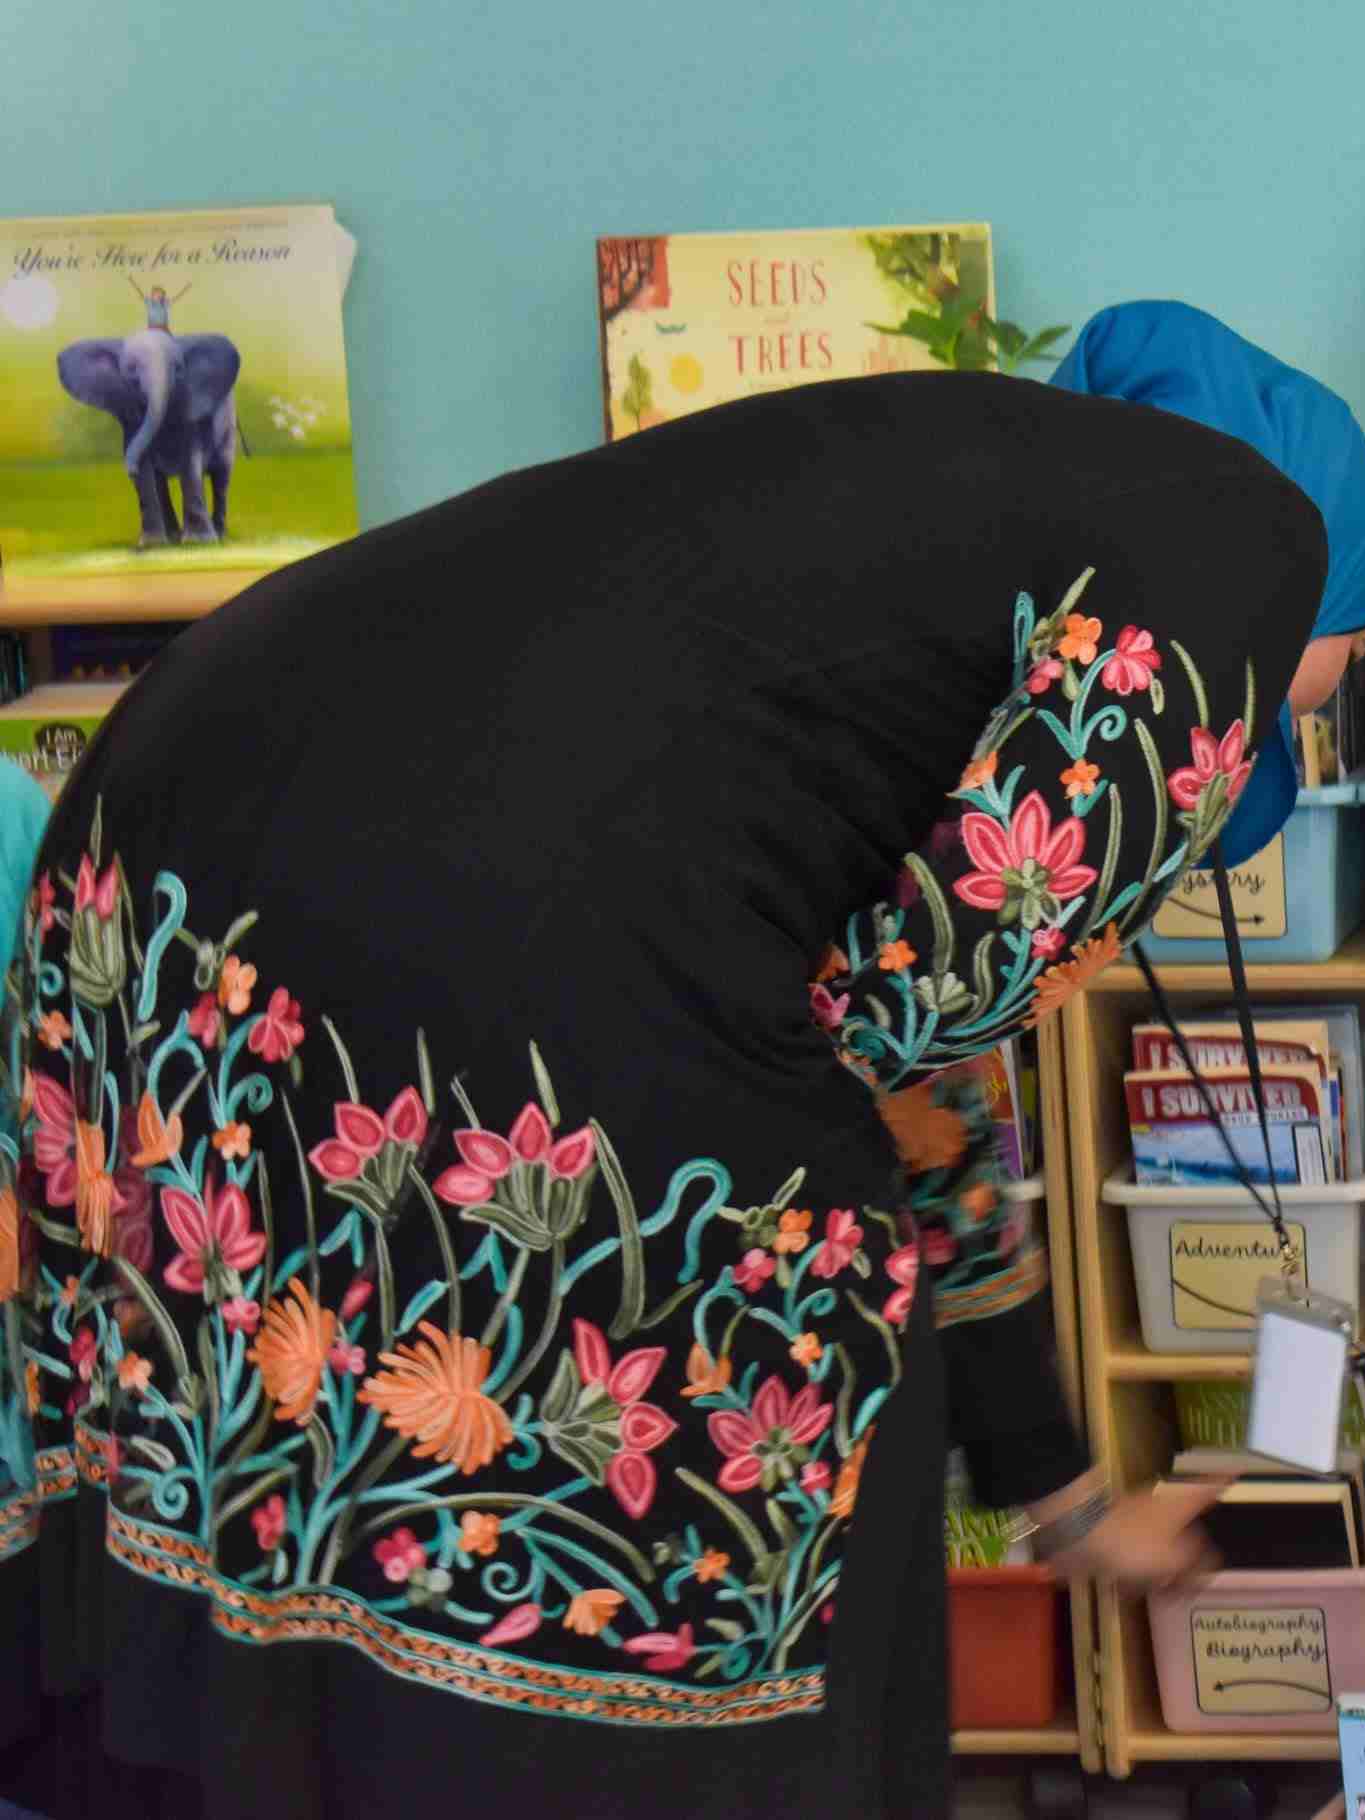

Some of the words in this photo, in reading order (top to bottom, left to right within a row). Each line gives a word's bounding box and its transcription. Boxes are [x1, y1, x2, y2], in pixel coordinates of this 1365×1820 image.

[151, 241, 180, 269] for
[206, 240, 293, 264] Reason
[727, 256, 827, 307] SEEDS
[727, 328, 832, 376] TREES
[1142, 1088, 1155, 1118] I
[1195, 1613, 1323, 1637] Autobiography
[1206, 1640, 1327, 1664] Biography
